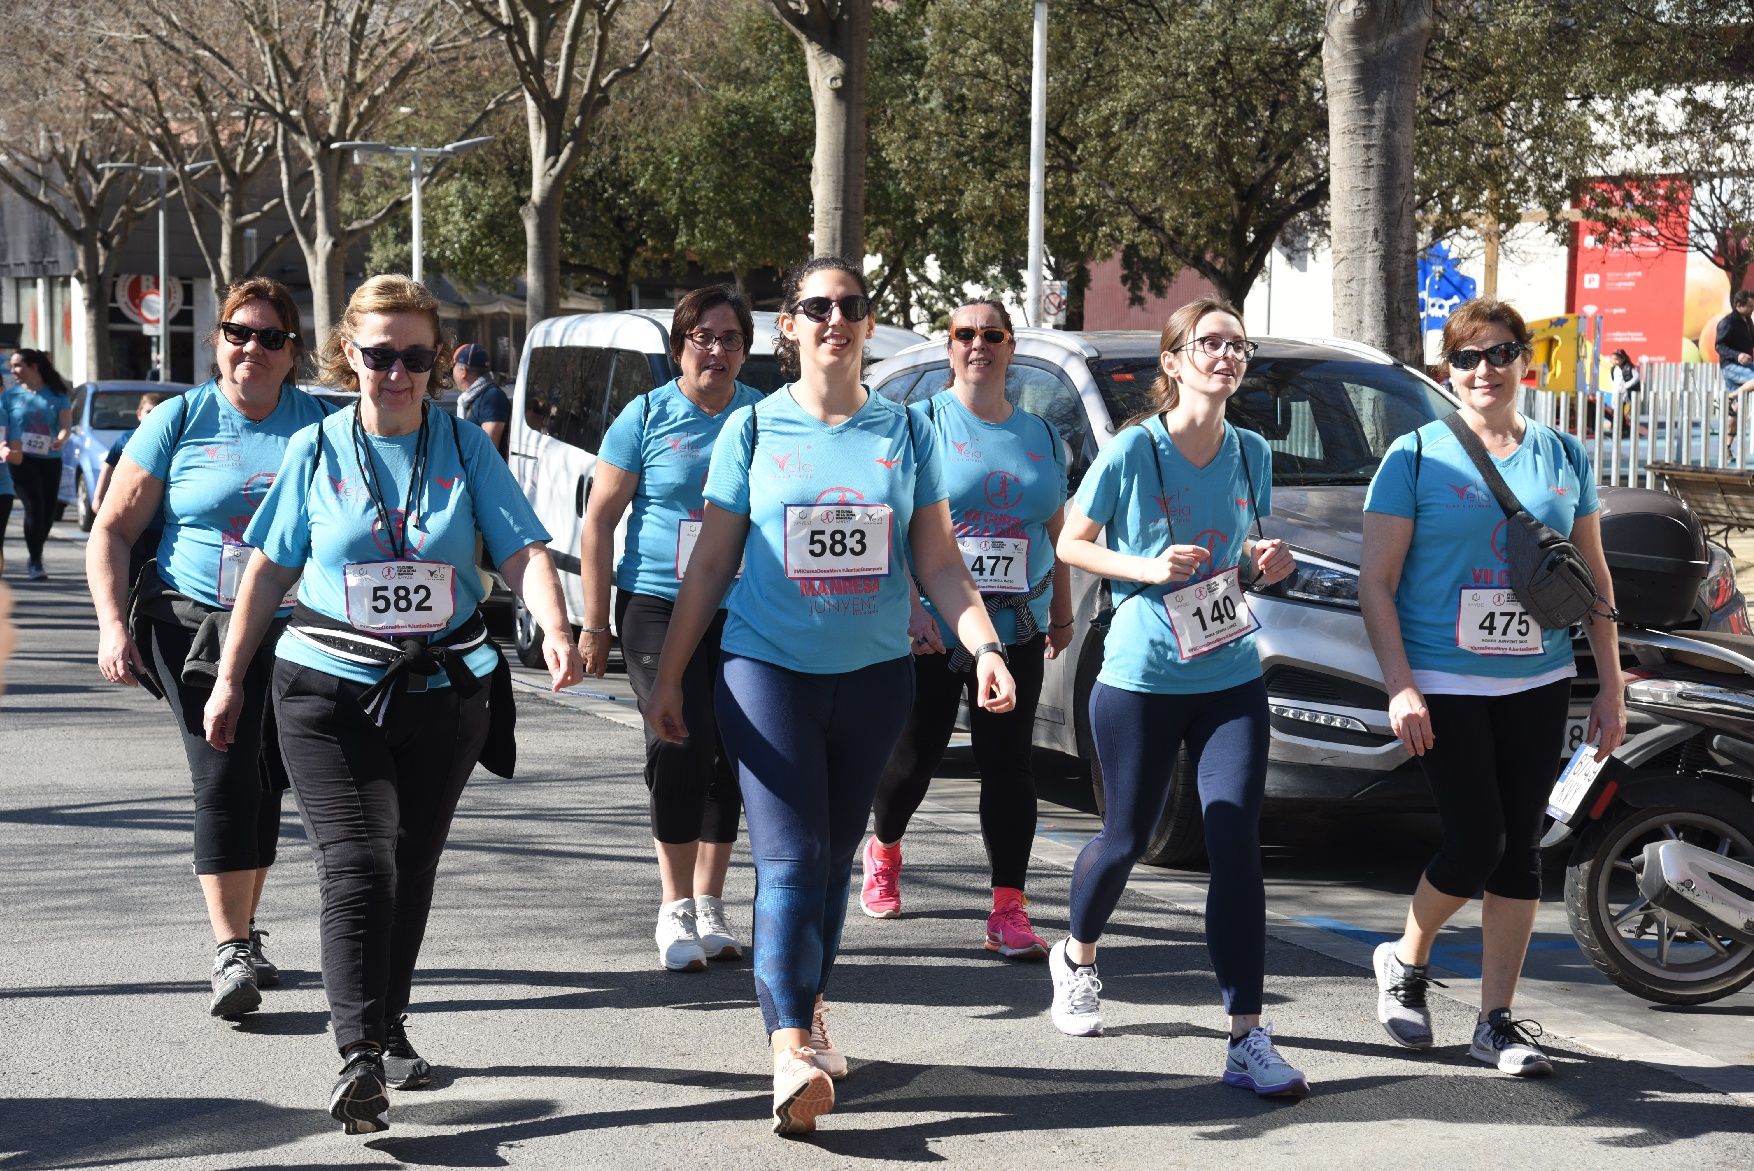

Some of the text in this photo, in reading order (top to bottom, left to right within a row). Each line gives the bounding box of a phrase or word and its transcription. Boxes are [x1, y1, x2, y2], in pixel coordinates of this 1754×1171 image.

[808, 529, 867, 557] 583
[971, 555, 1014, 576] 477
[371, 584, 433, 614] 582
[800, 577, 880, 597] MANRESA
[808, 595, 878, 617] JUNYENT
[1192, 595, 1236, 632] 140
[1478, 611, 1530, 637] 475
